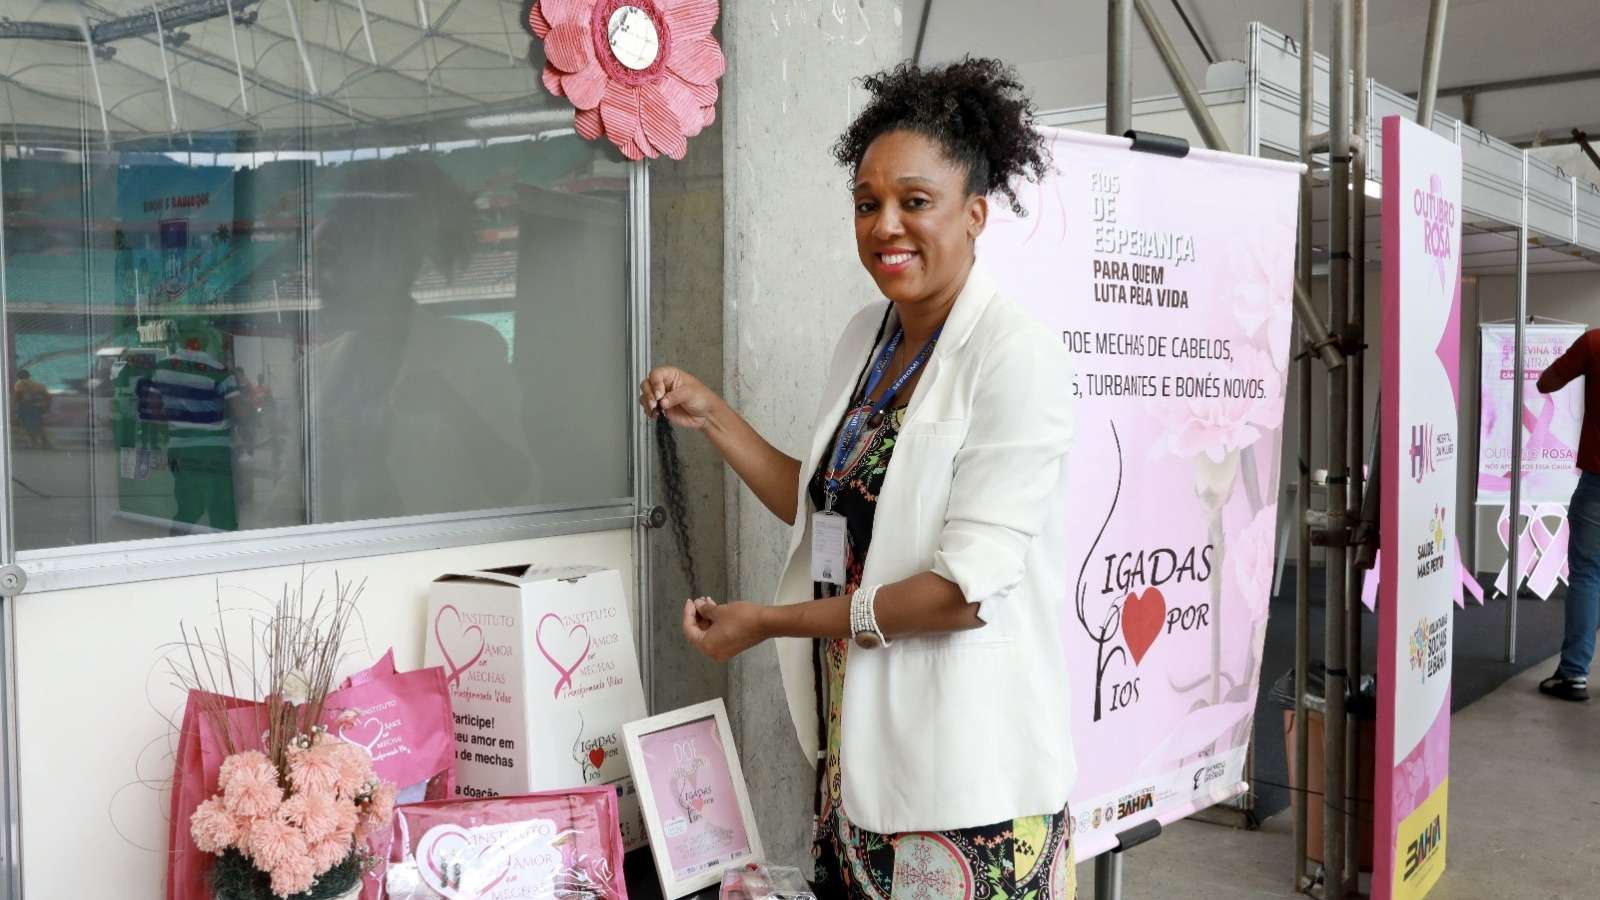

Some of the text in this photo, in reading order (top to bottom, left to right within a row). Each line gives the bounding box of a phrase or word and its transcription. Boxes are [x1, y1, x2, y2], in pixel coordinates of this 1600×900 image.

[1091, 172, 1120, 194] FIOS
[1093, 196, 1117, 223] DE
[1413, 188, 1455, 228] OUTUBRO
[1094, 226, 1196, 267] ESPERANÇA
[1424, 219, 1451, 259] ROSA
[1093, 259, 1164, 285] PARA QUEM
[1094, 282, 1189, 309] LUTA PELA VIDA
[1096, 333, 1144, 356] MECHAS
[1148, 335, 1167, 357] DE
[1172, 336, 1234, 363] CABELOS,
[1086, 373, 1157, 397] TURBANTES
[1162, 376, 1171, 397] E
[1175, 372, 1220, 398] BONÉS
[1223, 377, 1266, 399] NOVOS.
[1542, 448, 1574, 459] ROSA
[1167, 602, 1209, 634] POR
[484, 645, 513, 656] AMOR
[454, 733, 514, 750] eu amor em
[460, 750, 472, 763] de
[475, 753, 514, 769] mechas
